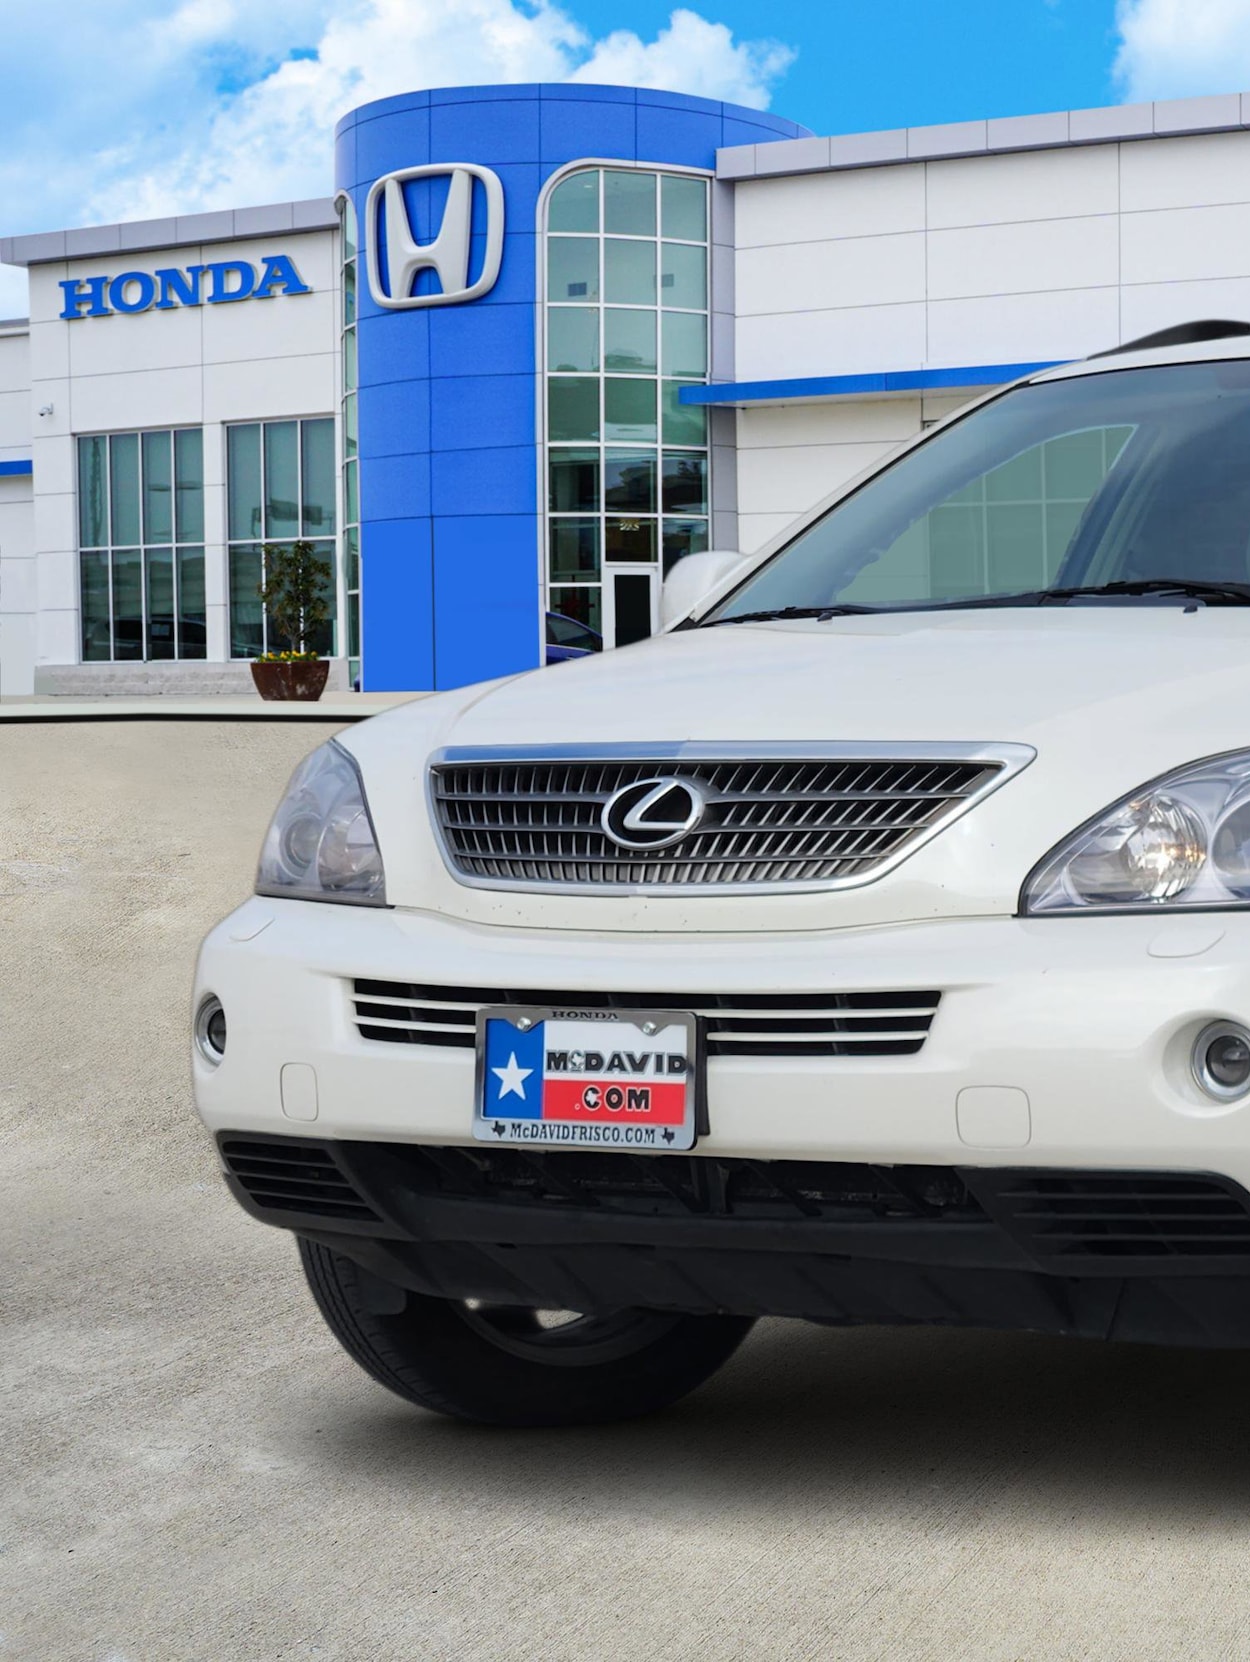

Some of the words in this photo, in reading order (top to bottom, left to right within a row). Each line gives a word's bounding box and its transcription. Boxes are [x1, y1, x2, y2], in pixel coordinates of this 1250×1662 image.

[58, 254, 312, 320] HONDA
[552, 1010, 618, 1020] HONDA
[510, 1122, 656, 1144] McDAVIDFRISCO.COM
